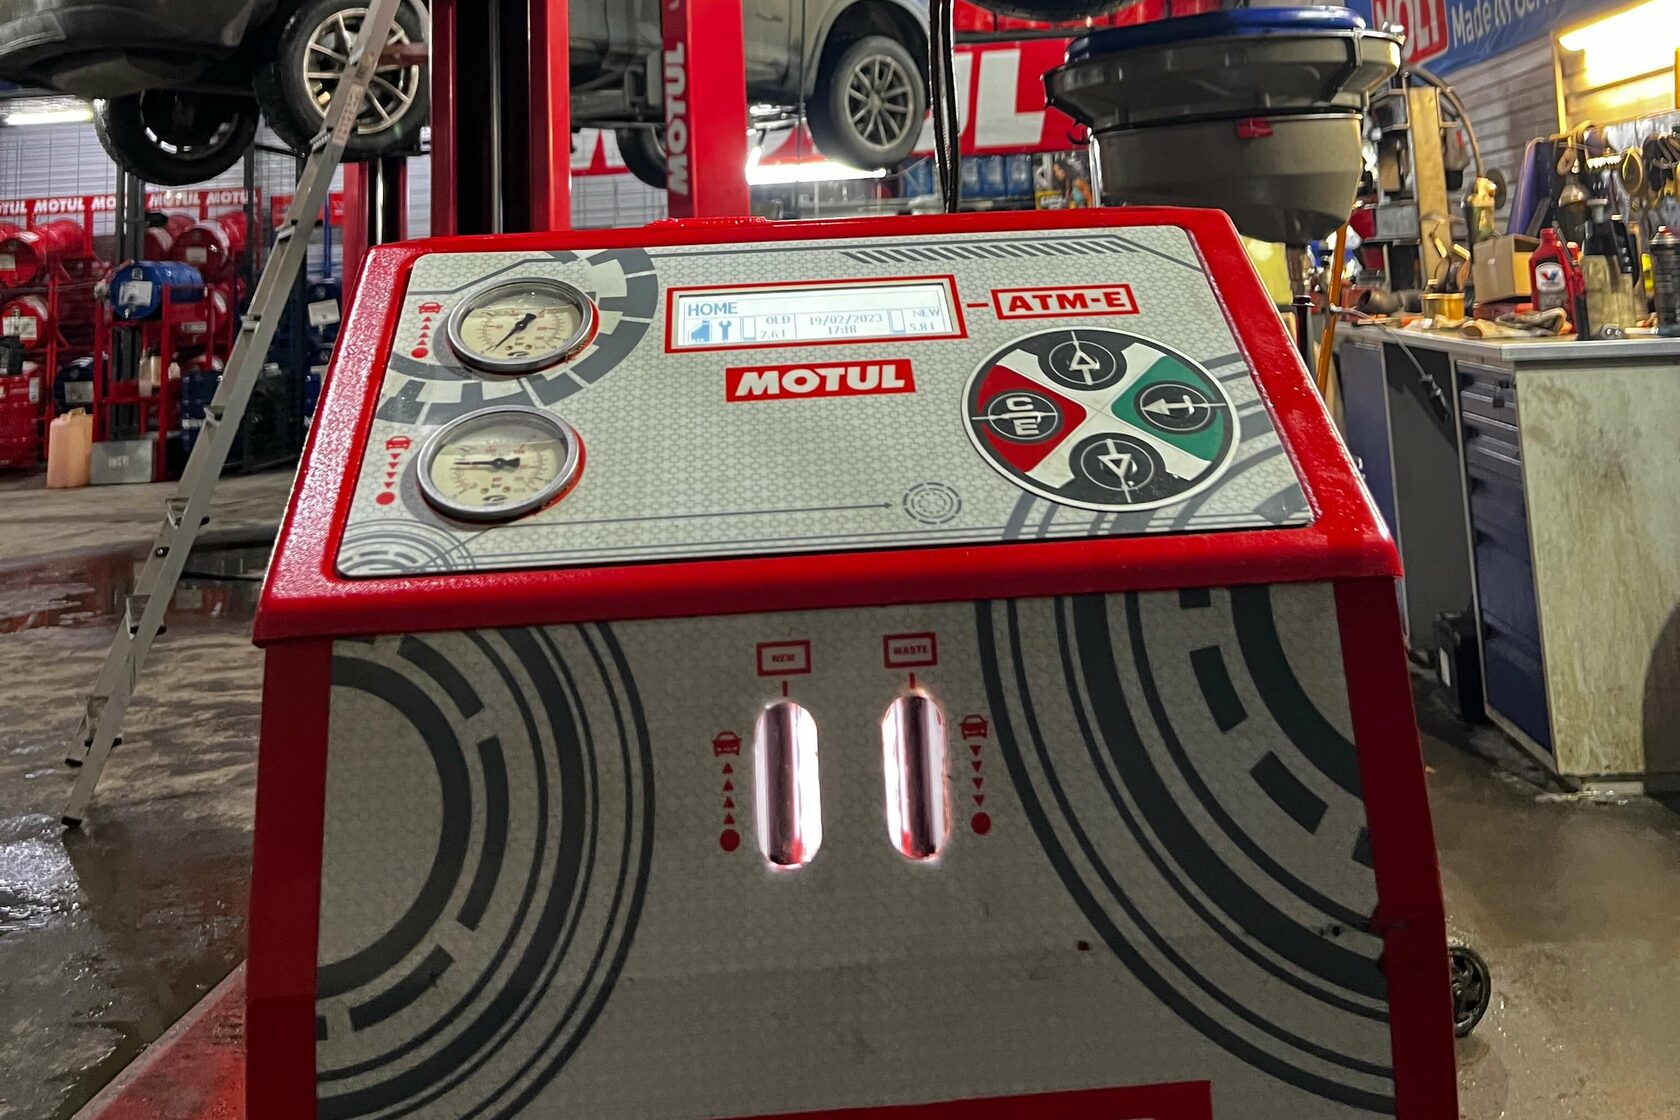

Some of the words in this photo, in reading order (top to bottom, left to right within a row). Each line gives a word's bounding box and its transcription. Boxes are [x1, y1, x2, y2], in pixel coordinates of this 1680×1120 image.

[664, 42, 688, 196] MOTUL
[0, 200, 27, 216] TUL
[34, 197, 85, 213] MOTUL
[1008, 291, 1126, 312] ATM-E
[687, 301, 738, 317] HOME
[912, 308, 941, 318] NEW
[765, 314, 791, 325] OLD
[809, 313, 883, 326] 19/02/2023
[828, 325, 858, 335] 17:18
[735, 364, 906, 397] MOTUL
[893, 645, 928, 655] WASTE
[771, 653, 796, 663] NEW
